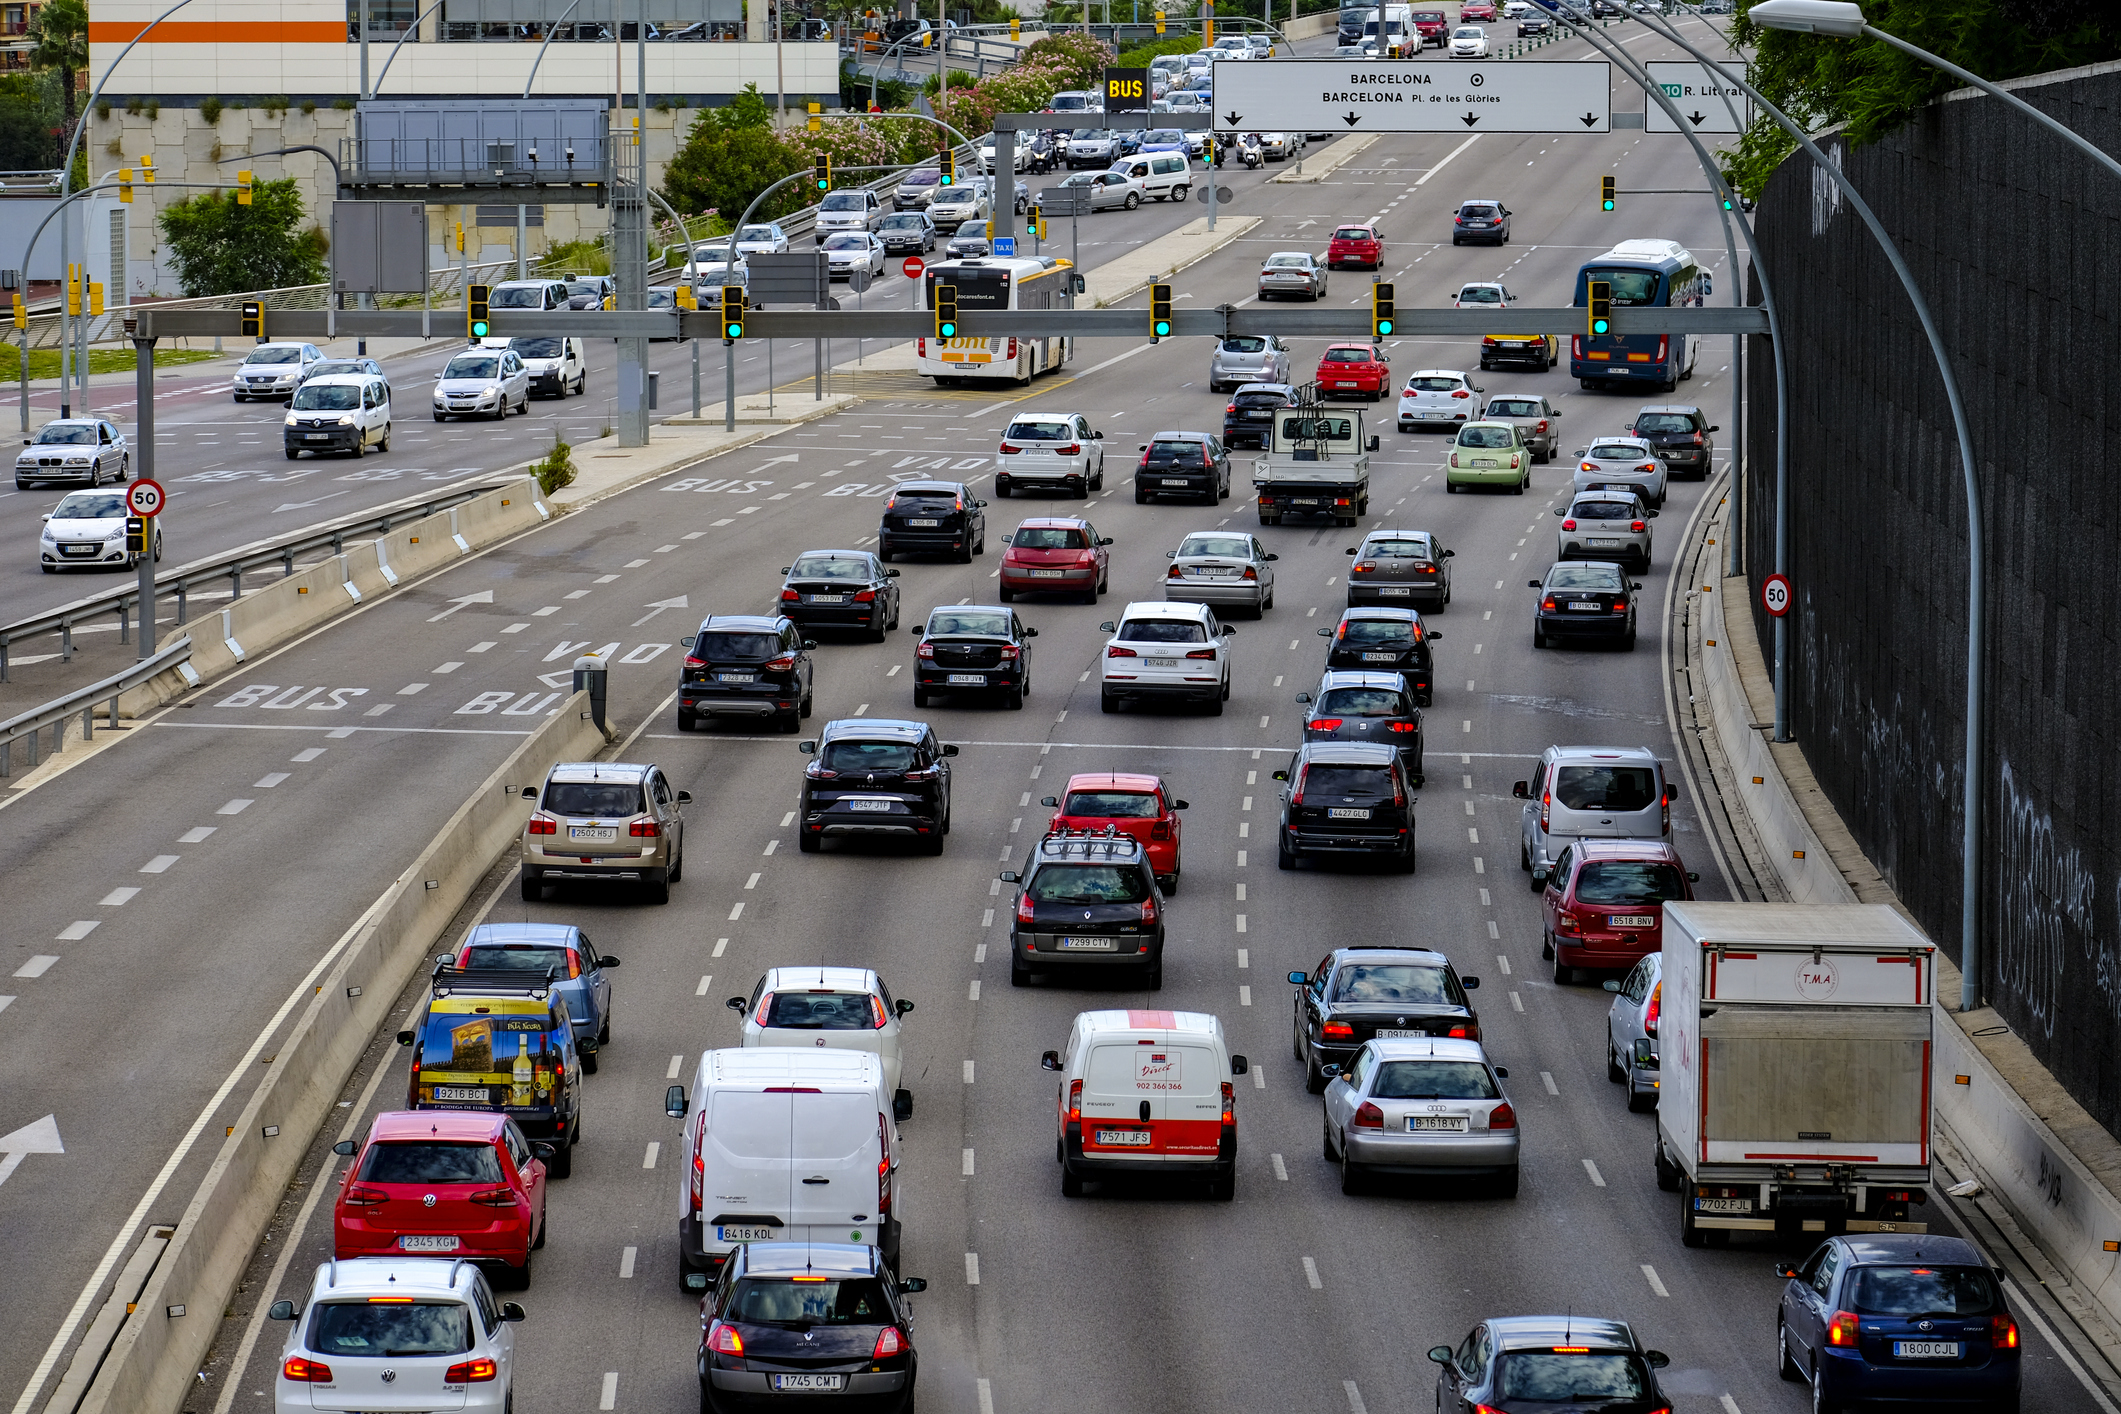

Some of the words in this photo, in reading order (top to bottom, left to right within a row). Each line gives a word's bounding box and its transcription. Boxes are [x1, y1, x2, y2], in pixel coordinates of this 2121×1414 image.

[1350, 74, 1432, 85] BARCELONA
[1109, 79, 1143, 98] BUS
[1684, 86, 1696, 96] R.
[1701, 86, 1743, 96] Litral
[1322, 92, 1403, 103] BARCELONA
[1412, 94, 1425, 103] Pl.
[1429, 94, 1442, 103] de
[1446, 94, 1461, 103] les
[1465, 93, 1501, 103] Glòries
[995, 244, 1013, 252] TAXI
[659, 478, 773, 494] BUS
[821, 483, 898, 498] BU
[134, 492, 157, 505] 50
[1768, 588, 1785, 603] 50
[1148, 659, 1163, 667] 5746
[953, 674, 968, 682] 0948
[213, 684, 370, 711] BUS
[854, 800, 872, 809] 8547
[874, 800, 888, 809] JTF
[1333, 810, 1351, 818] 4427
[576, 829, 596, 838] 2502
[597, 829, 613, 838] HSJ
[1613, 916, 1634, 925] 6518
[1637, 916, 1653, 926] BNV
[1069, 938, 1091, 947] 7299
[1092, 938, 1108, 947] CTV
[1141, 1062, 1176, 1077] Direct
[1136, 1082, 1150, 1090] 902
[1152, 1082, 1167, 1090] 366
[1168, 1083, 1182, 1091] 366
[441, 1089, 465, 1099] 9216
[468, 1089, 487, 1099] BCT
[1102, 1132, 1126, 1142] 7571
[1129, 1132, 1148, 1143] JFS
[1701, 1200, 1727, 1210] 7702
[1729, 1200, 1749, 1211] FJL
[725, 1229, 751, 1240] 6416
[754, 1229, 773, 1240] KDL
[406, 1237, 433, 1247] 2345
[436, 1237, 457, 1247] KGM
[1902, 1343, 1931, 1354] 1800
[1934, 1344, 1955, 1355] CJL
[785, 1376, 811, 1387] 1745
[816, 1376, 837, 1387] CMT
